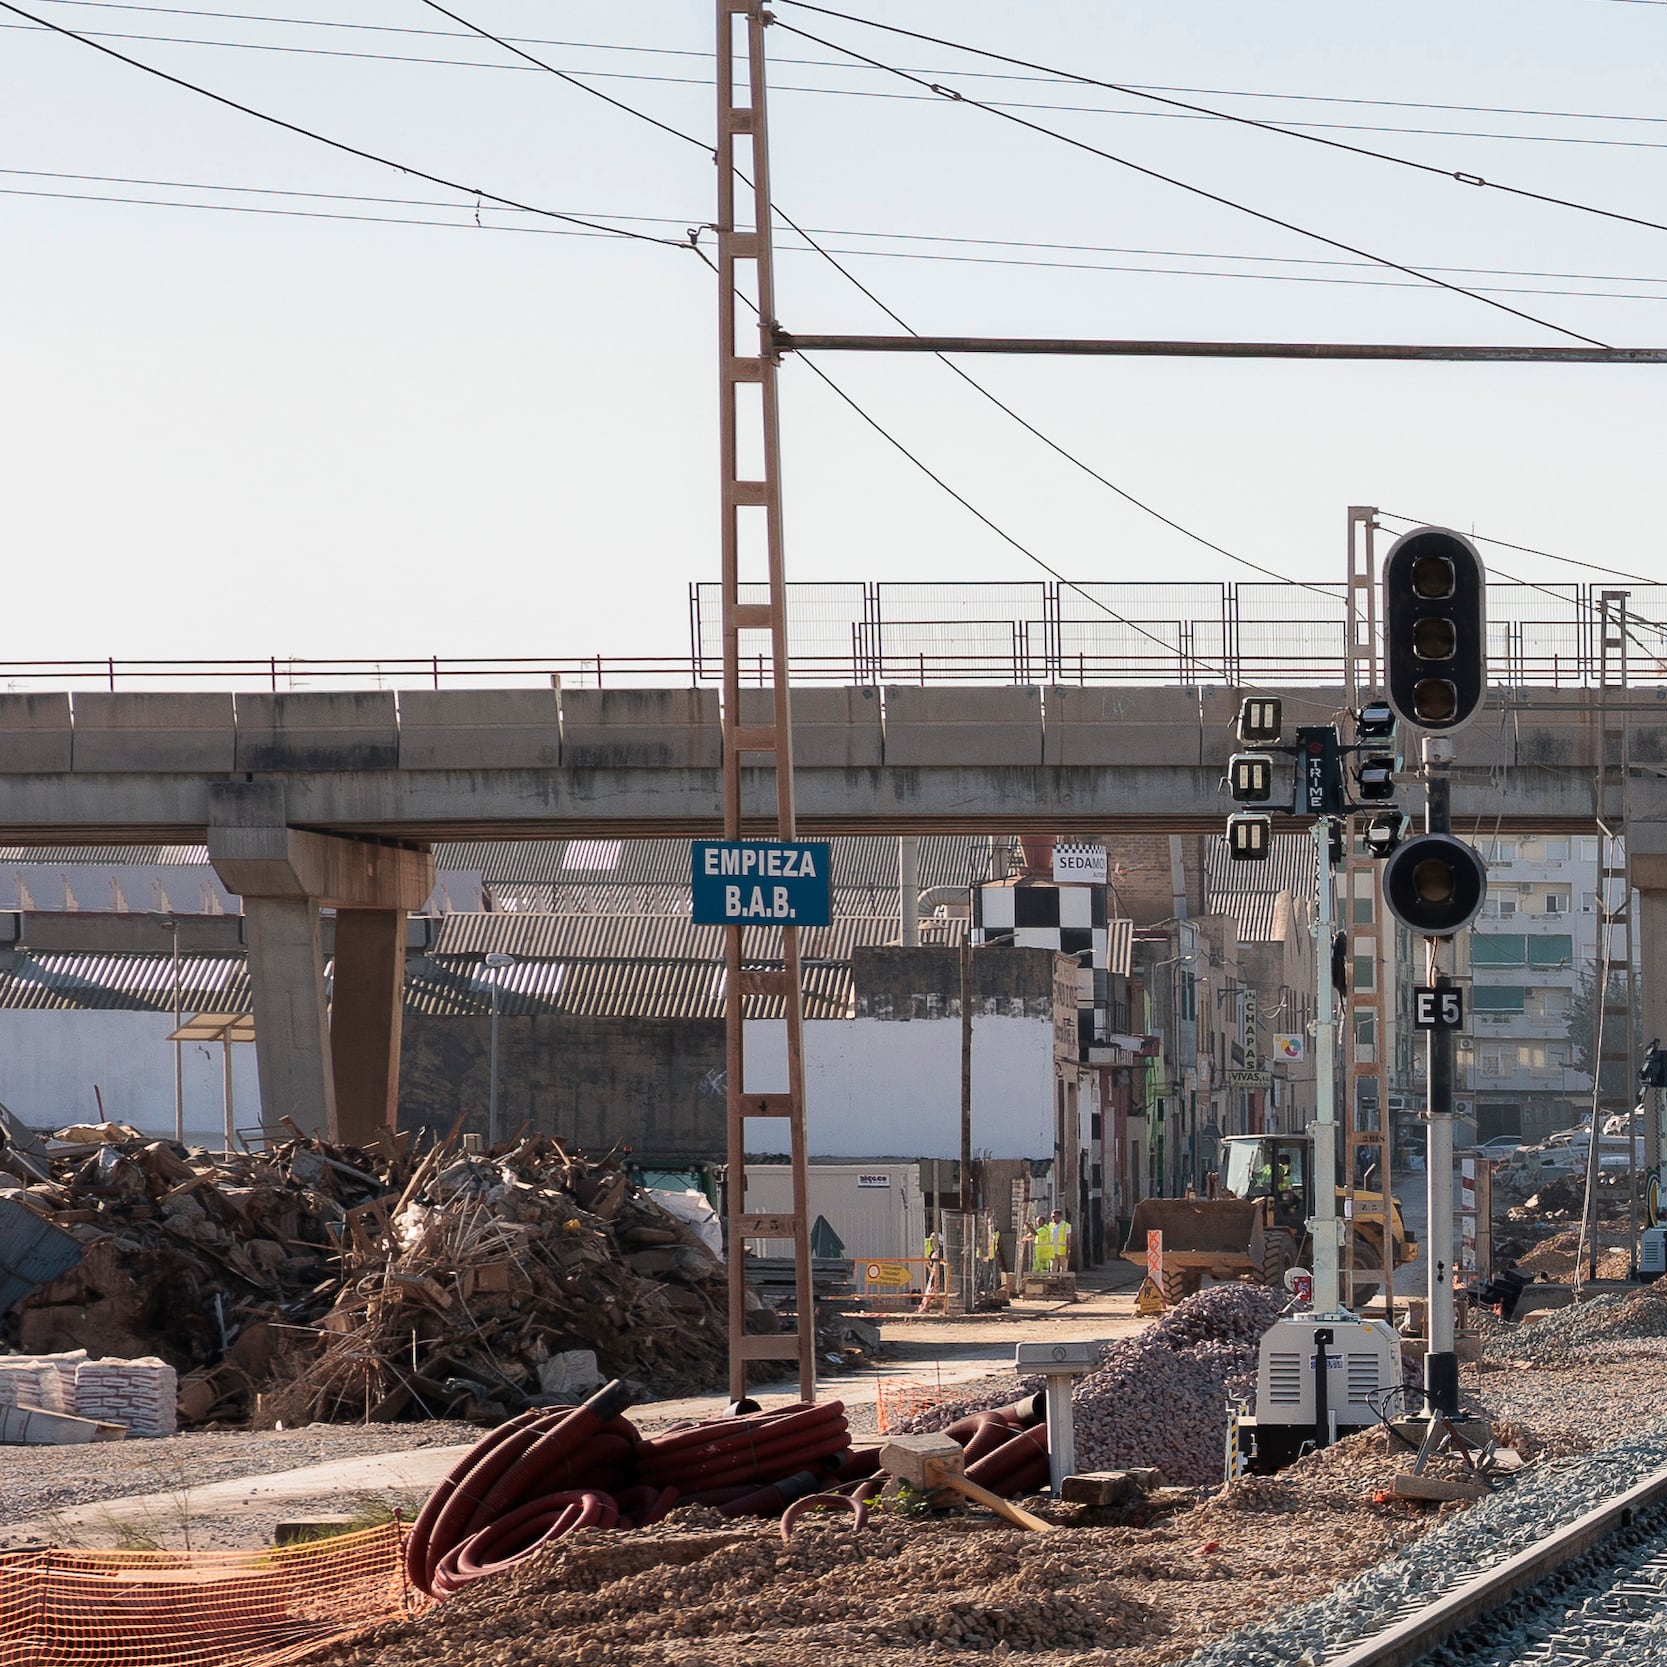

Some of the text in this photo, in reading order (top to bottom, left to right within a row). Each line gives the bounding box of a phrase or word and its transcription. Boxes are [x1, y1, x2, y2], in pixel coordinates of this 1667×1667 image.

[1310, 758, 1323, 807] TRIME
[704, 848, 817, 877] EMPIEZA
[725, 885, 796, 918] B.A.B.
[1246, 1003, 1255, 1070] CHAPAS
